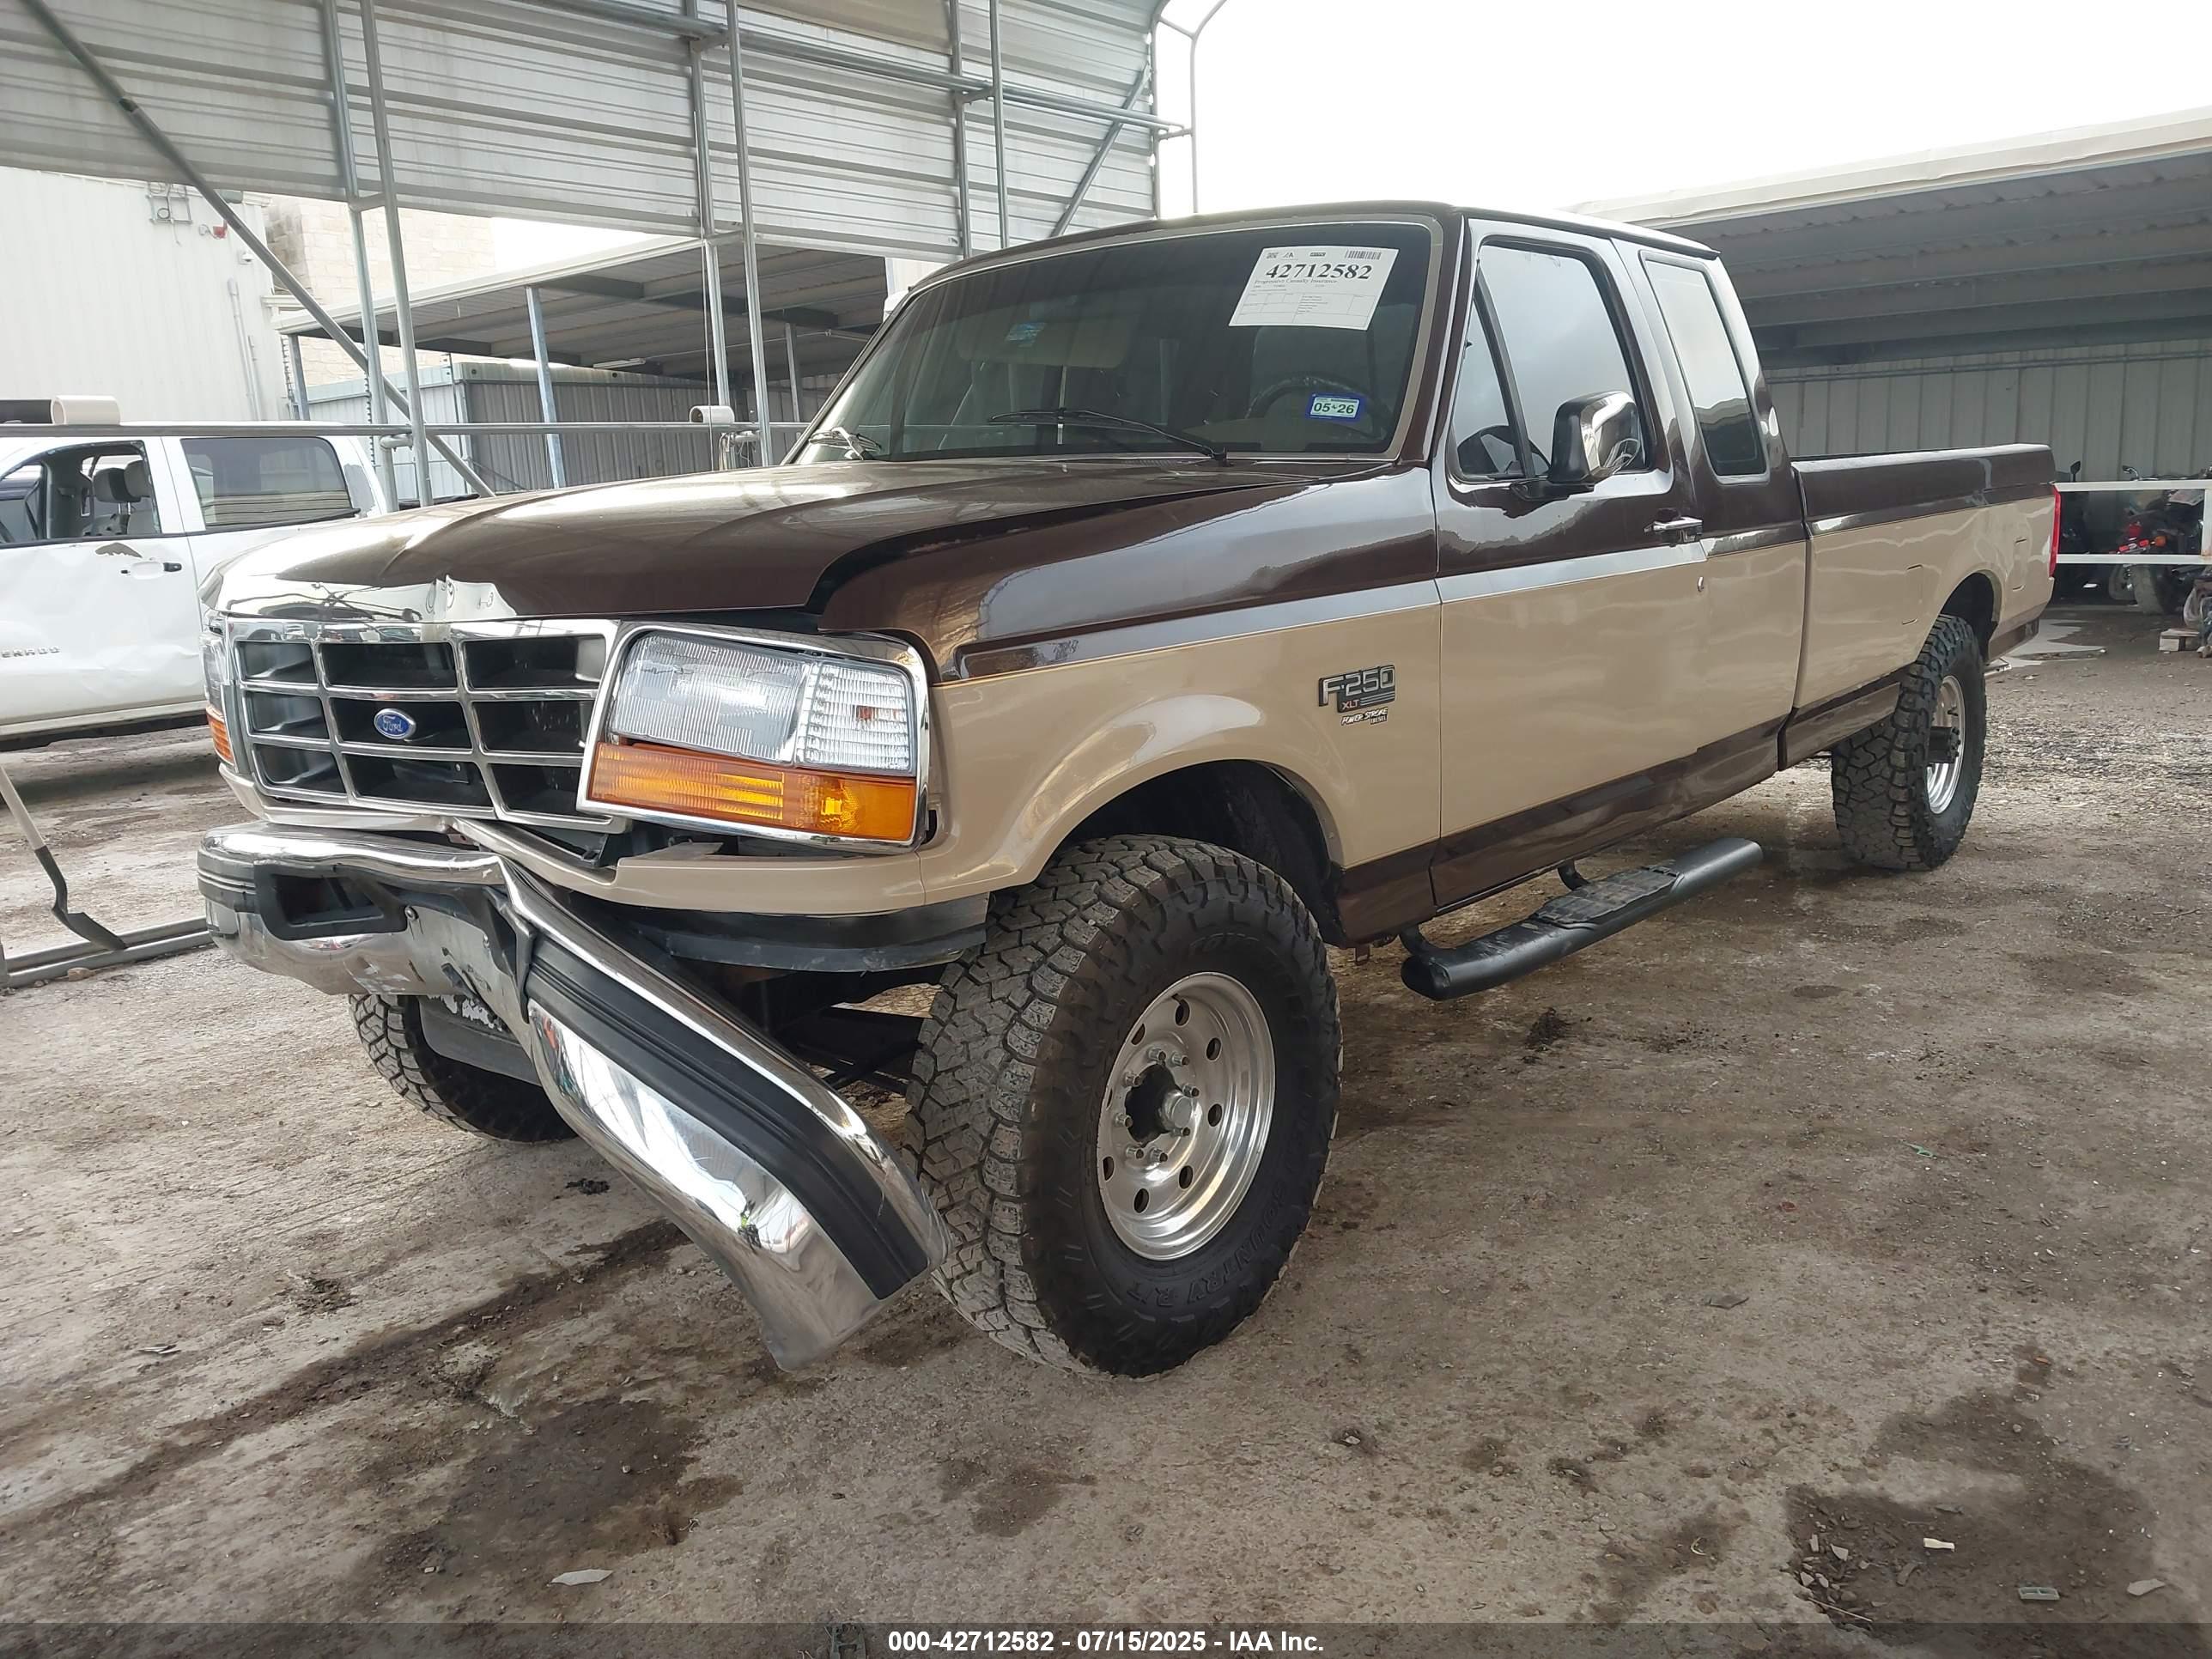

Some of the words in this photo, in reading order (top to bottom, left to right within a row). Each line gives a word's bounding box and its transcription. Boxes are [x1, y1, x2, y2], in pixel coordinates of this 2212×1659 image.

[1266, 263, 1372, 280] 42712582
[1313, 403, 1331, 412] 05
[1337, 404, 1355, 414] 26
[1341, 699, 1360, 710] XLT
[1341, 714, 1364, 726] POWER
[1364, 708, 1389, 720] STROKE
[1370, 715, 1388, 725] DIESEL
